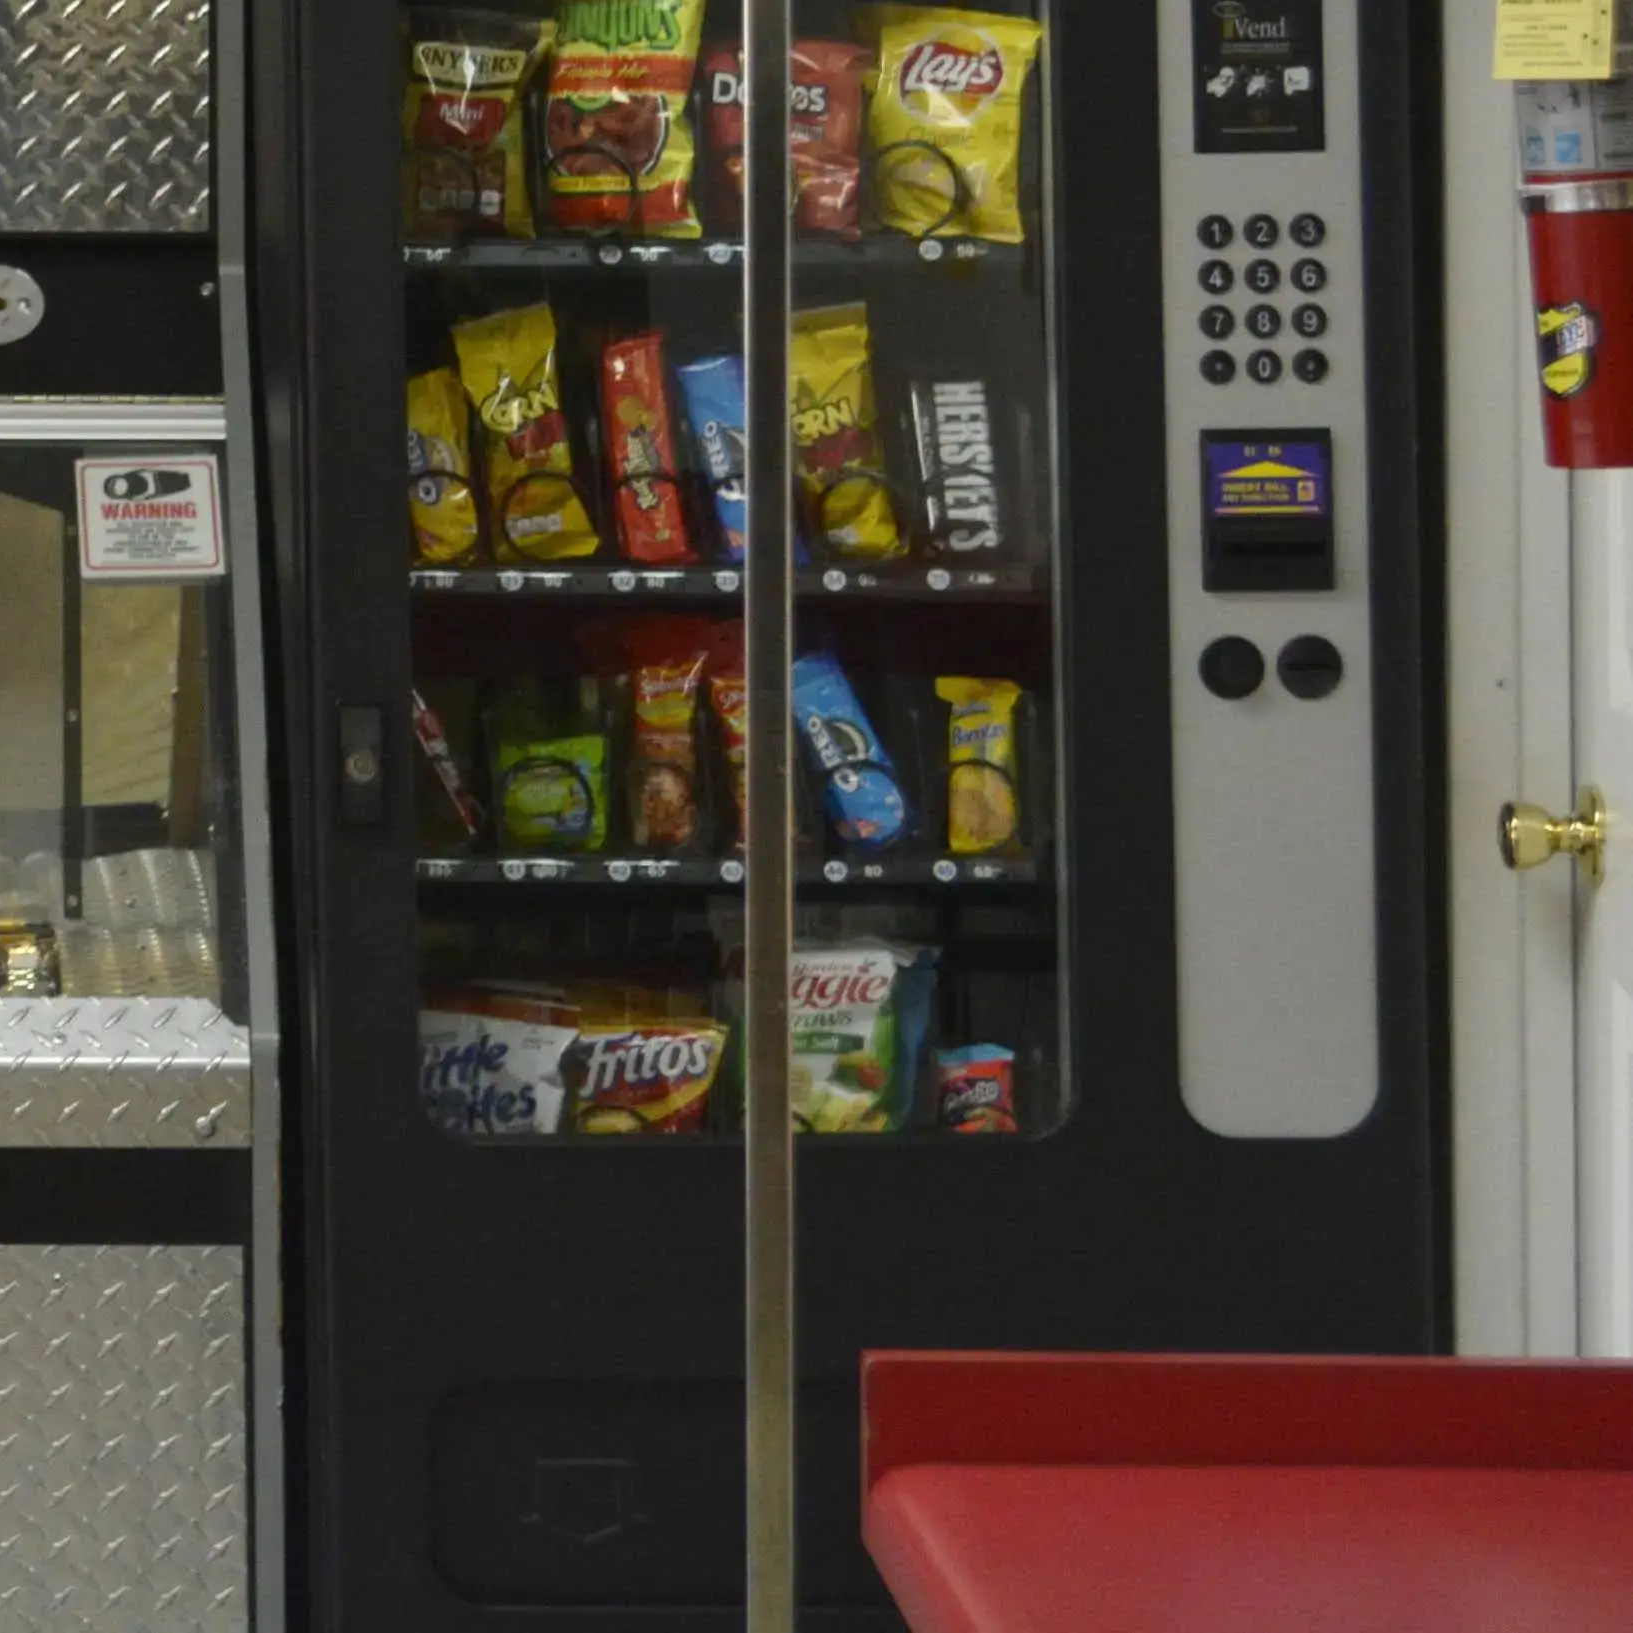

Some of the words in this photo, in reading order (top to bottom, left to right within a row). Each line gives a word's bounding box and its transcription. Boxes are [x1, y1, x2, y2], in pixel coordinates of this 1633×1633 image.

[903, 42, 998, 92] Lay's
[1209, 221, 1221, 243] 1
[1255, 221, 1269, 243] 2
[1301, 219, 1316, 241] 3
[1208, 265, 1224, 288] 4
[1255, 265, 1270, 287] 5
[1301, 264, 1316, 287] 6
[1211, 311, 1224, 333] 7
[1256, 310, 1271, 333] 8
[1303, 310, 1317, 332] 9
[1257, 356, 1271, 378] 0
[933, 380, 1000, 552] HERSHEY'S
[101, 500, 197, 520] WARNING
